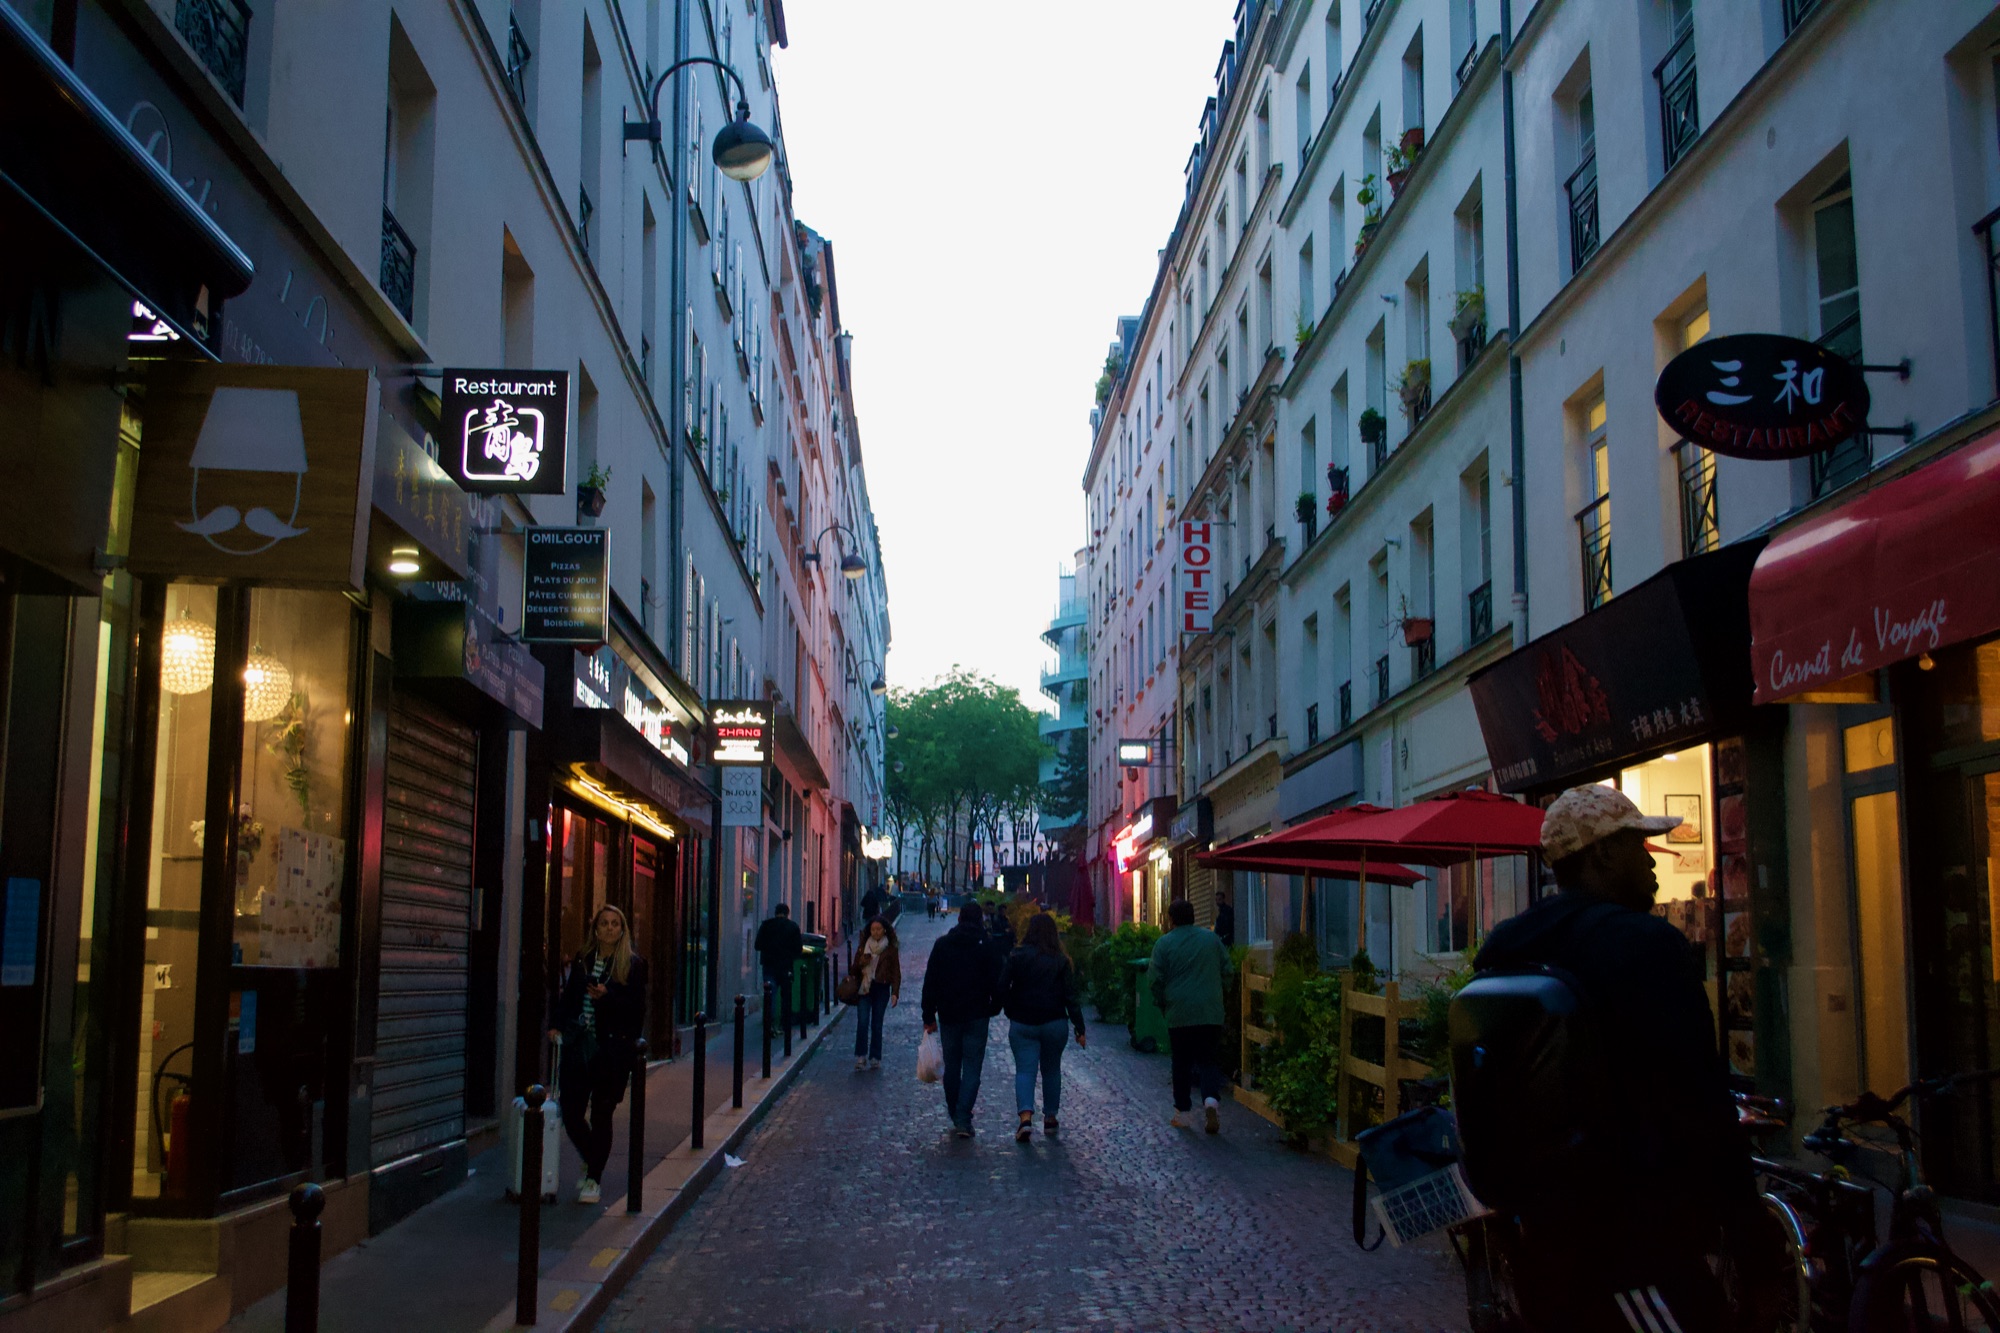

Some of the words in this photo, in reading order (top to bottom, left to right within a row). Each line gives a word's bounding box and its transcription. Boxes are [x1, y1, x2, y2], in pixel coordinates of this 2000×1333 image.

[455, 378, 557, 397] Restaurant
[1705, 359, 1824, 415] 三和
[1674, 399, 1854, 450] RESTAURANT
[531, 533, 602, 545] OMILGOUT
[1183, 522, 1211, 632] HOTEL
[1769, 638, 1831, 691] Carnet
[1841, 626, 1863, 669] de
[1873, 598, 1947, 654] Voyage
[713, 707, 766, 724] Sushi
[718, 728, 762, 737] ZHANG
